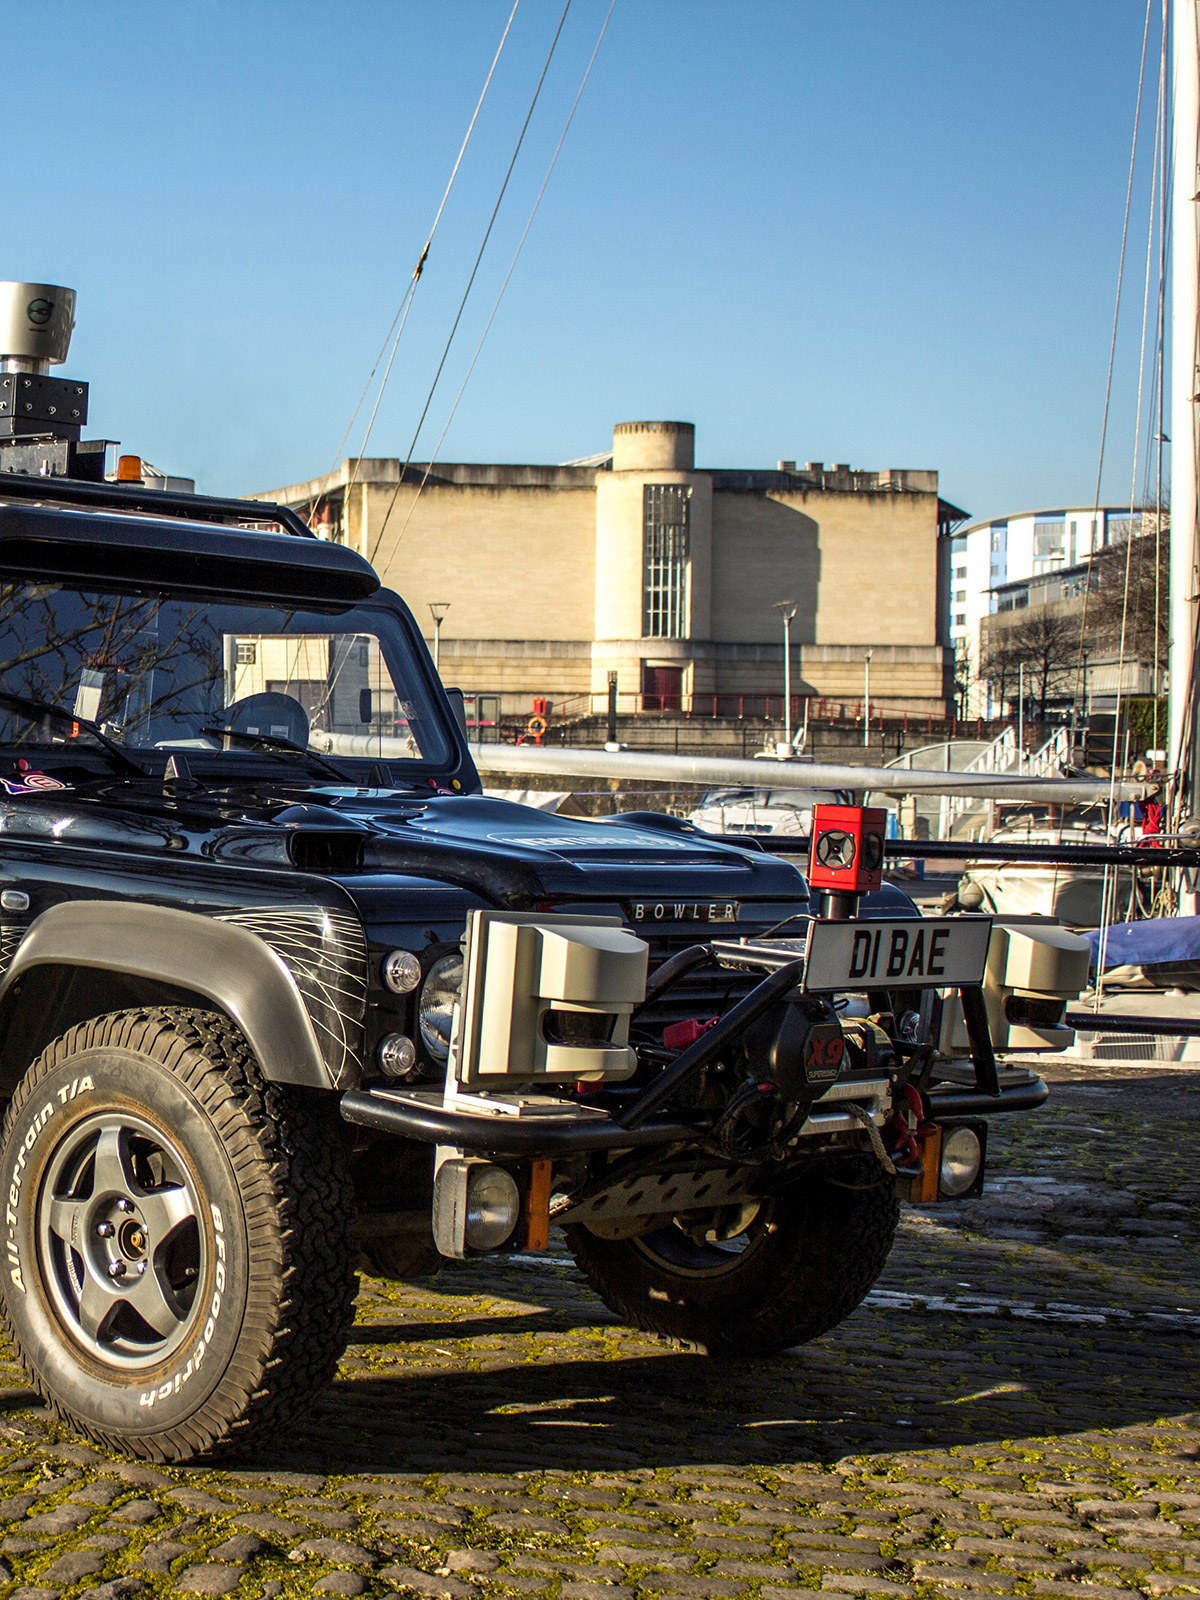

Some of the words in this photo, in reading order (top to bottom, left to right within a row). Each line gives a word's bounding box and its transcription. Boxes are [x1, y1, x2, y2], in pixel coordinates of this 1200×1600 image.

[635, 903, 734, 919] BOWLER
[886, 928, 950, 977] BAE
[807, 1039, 845, 1066] X9
[6, 1102, 55, 1294] All-Terrain
[57, 1075, 95, 1104] T/A
[139, 1203, 227, 1408] BFGoodrich
